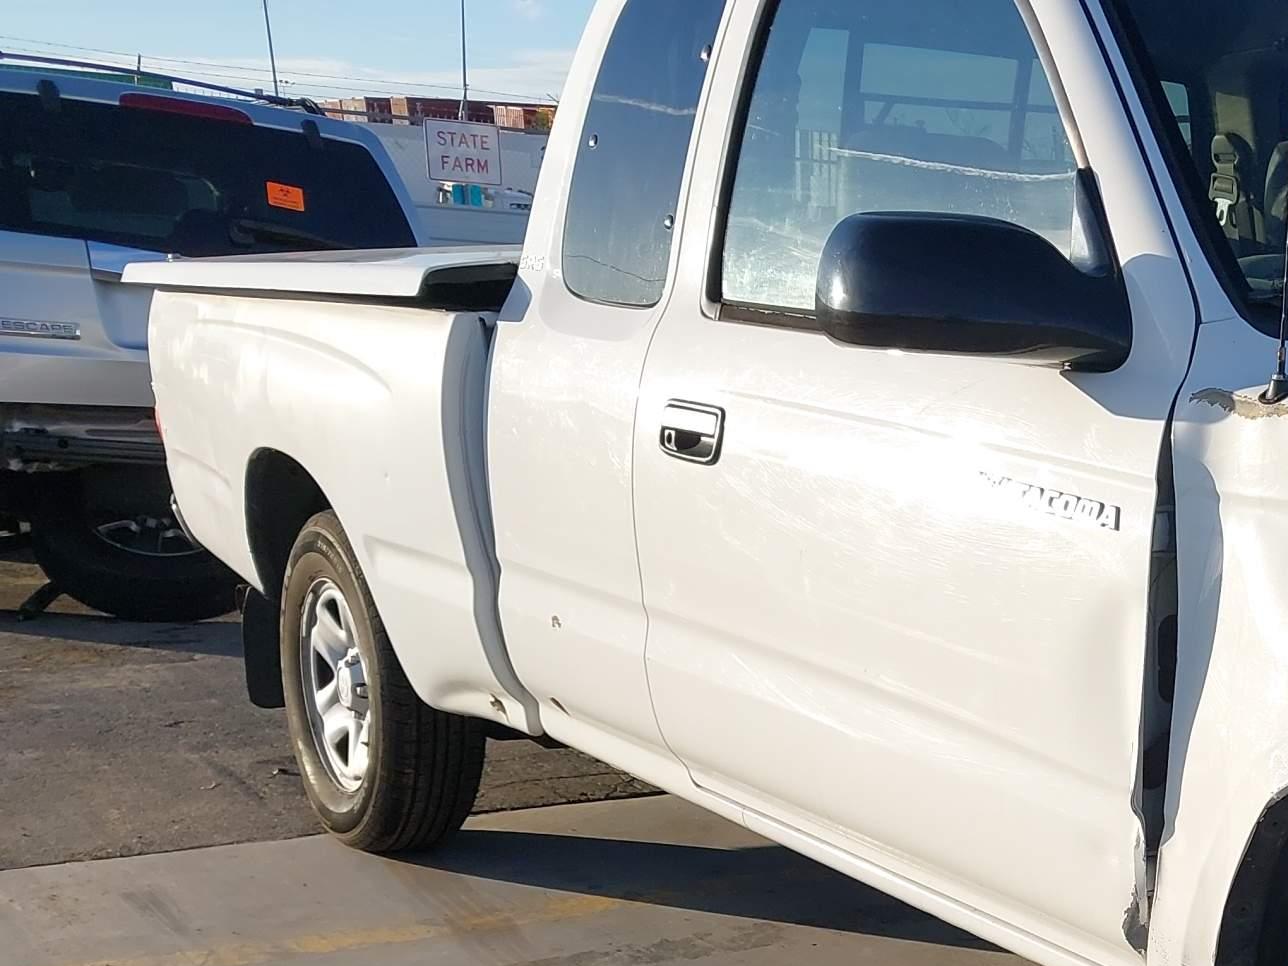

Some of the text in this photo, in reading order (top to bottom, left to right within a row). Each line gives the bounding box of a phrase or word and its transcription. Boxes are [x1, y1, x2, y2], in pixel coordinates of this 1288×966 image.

[437, 131, 491, 151] STATE
[441, 155, 489, 175] FARM
[1, 320, 73, 334] ESCAPE
